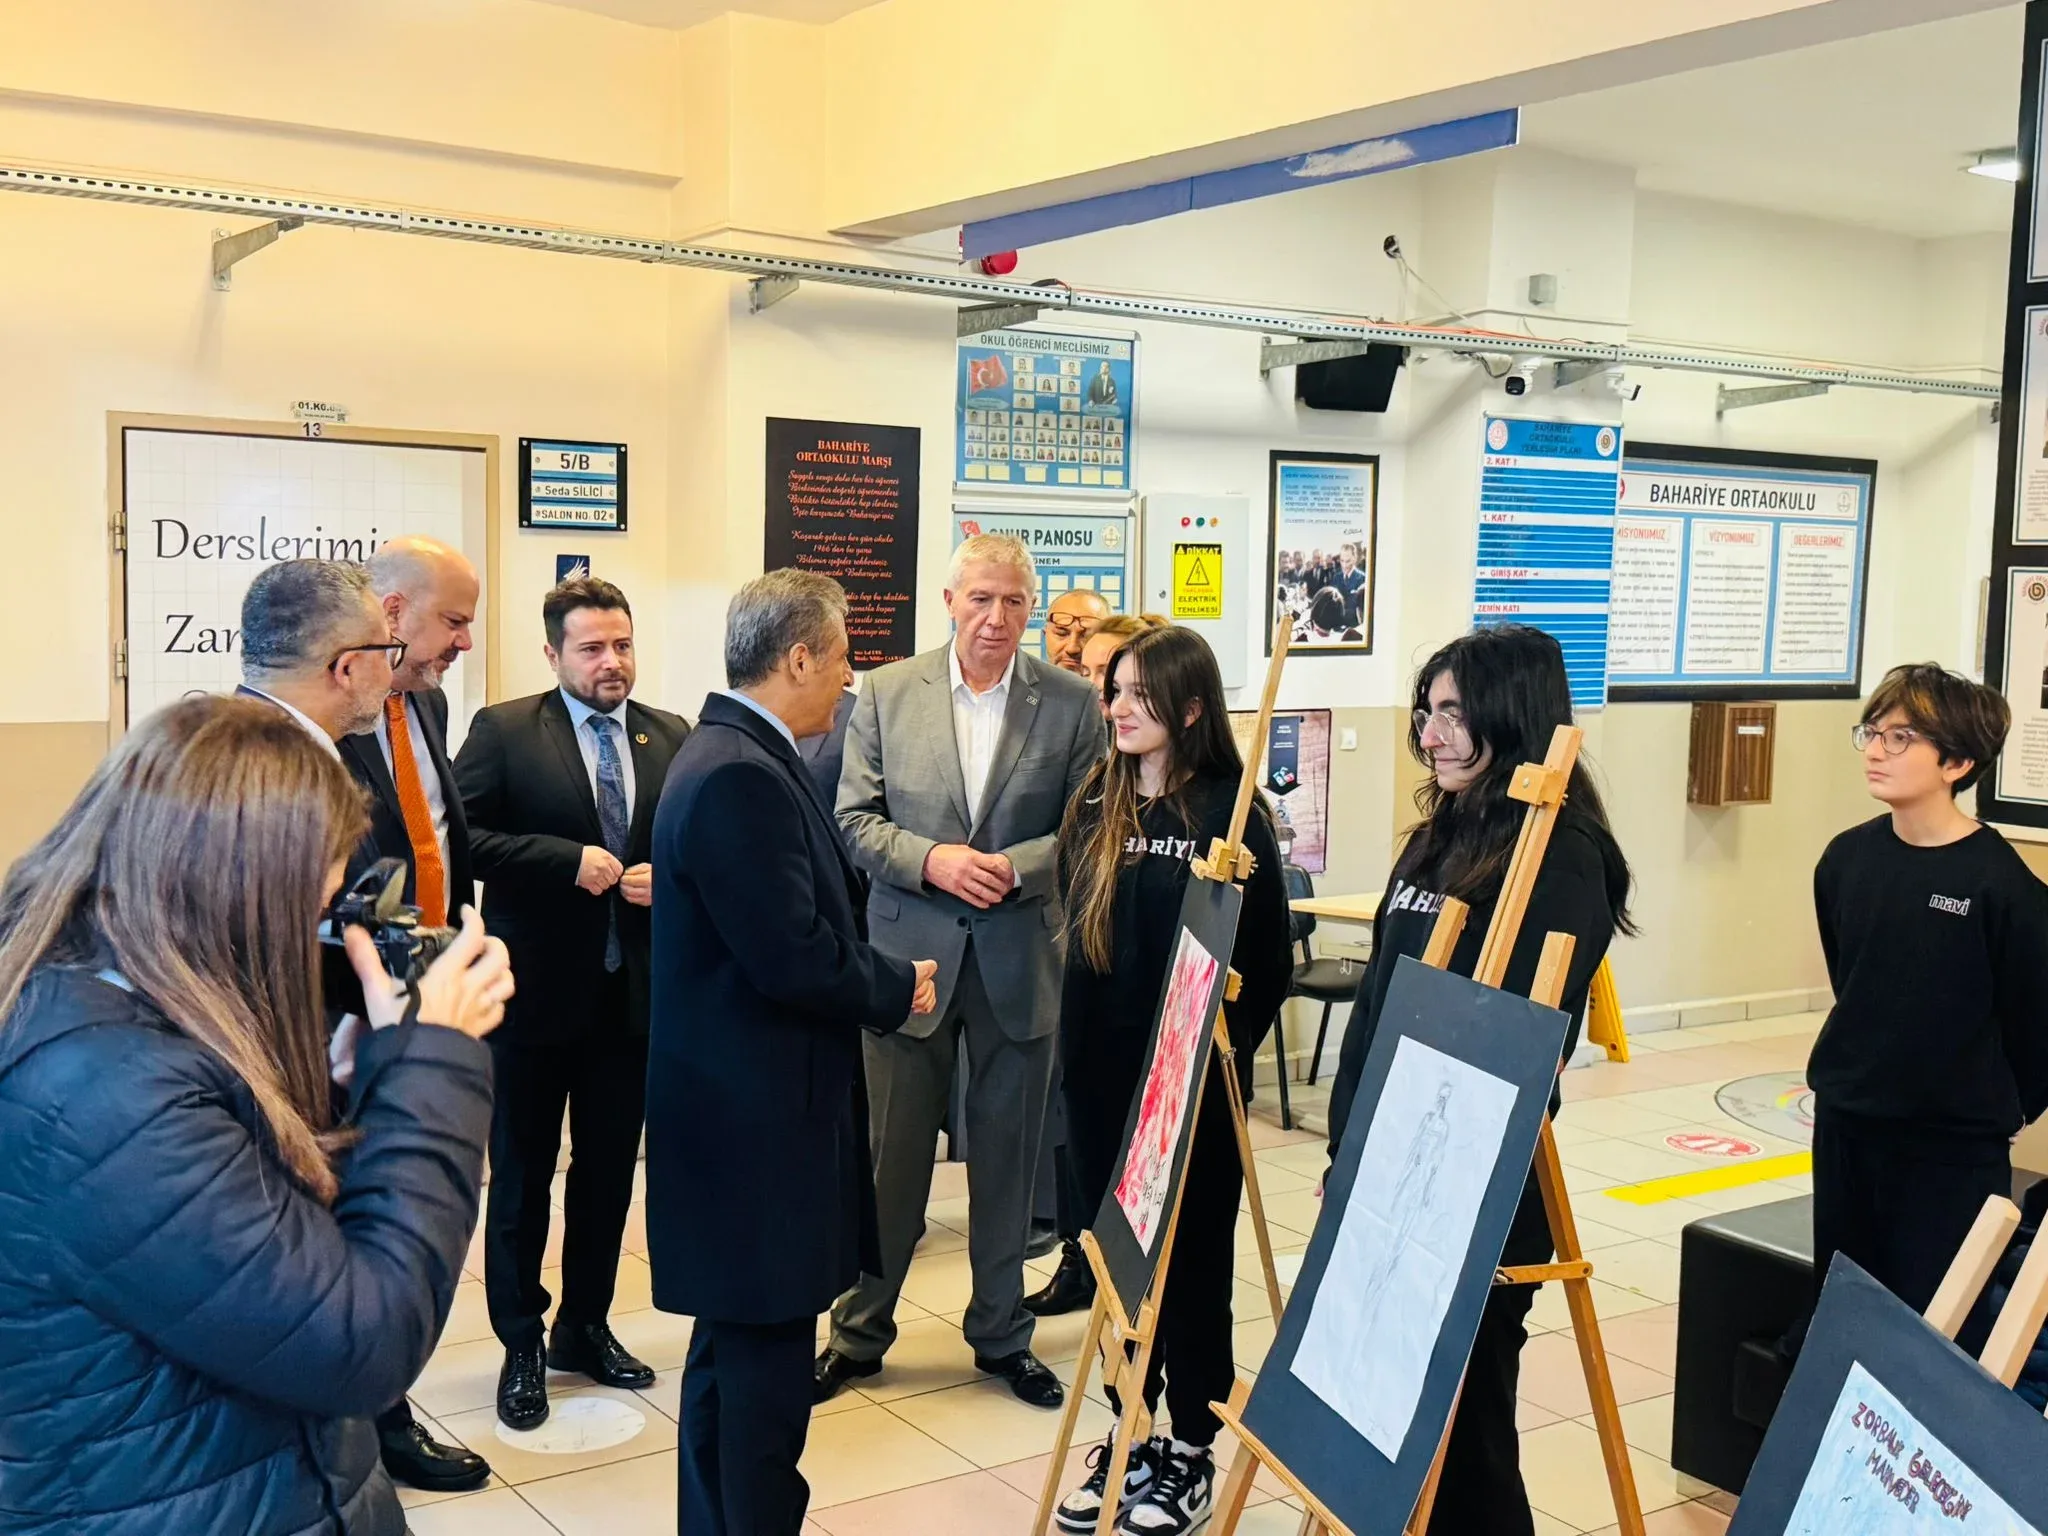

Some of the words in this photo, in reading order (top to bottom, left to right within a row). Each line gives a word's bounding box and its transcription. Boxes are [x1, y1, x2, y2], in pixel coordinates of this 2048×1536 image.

[980, 334, 1006, 347] OKUL
[1008, 335, 1051, 351] ÖĞRENCİ
[1053, 341, 1110, 355] MECLİSİMİZ
[302, 422, 322, 437] 13
[818, 440, 871, 453] BAHARİYE
[560, 453, 590, 471] 5/B
[796, 451, 860, 465] ORTAOKULU
[861, 456, 893, 468] MARŞI
[1495, 458, 1510, 466] KAT
[545, 485, 570, 497] Seda
[573, 486, 603, 497] SİLİCİ
[1650, 483, 1726, 506] BAHARİYE
[1731, 488, 1816, 511] ORTAOKULU
[542, 510, 573, 520] SALON
[594, 510, 608, 521] 02
[1491, 514, 1507, 522] KAT
[151, 516, 388, 562] Derslerimi
[1034, 530, 1093, 546] PANOSU
[1490, 569, 1511, 578] GİRİŞ
[1178, 595, 1217, 603] ELEKTRİK
[1477, 604, 1501, 612] ZEMİN
[1122, 836, 1196, 862] HARİY
[1928, 894, 1971, 916] mavi
